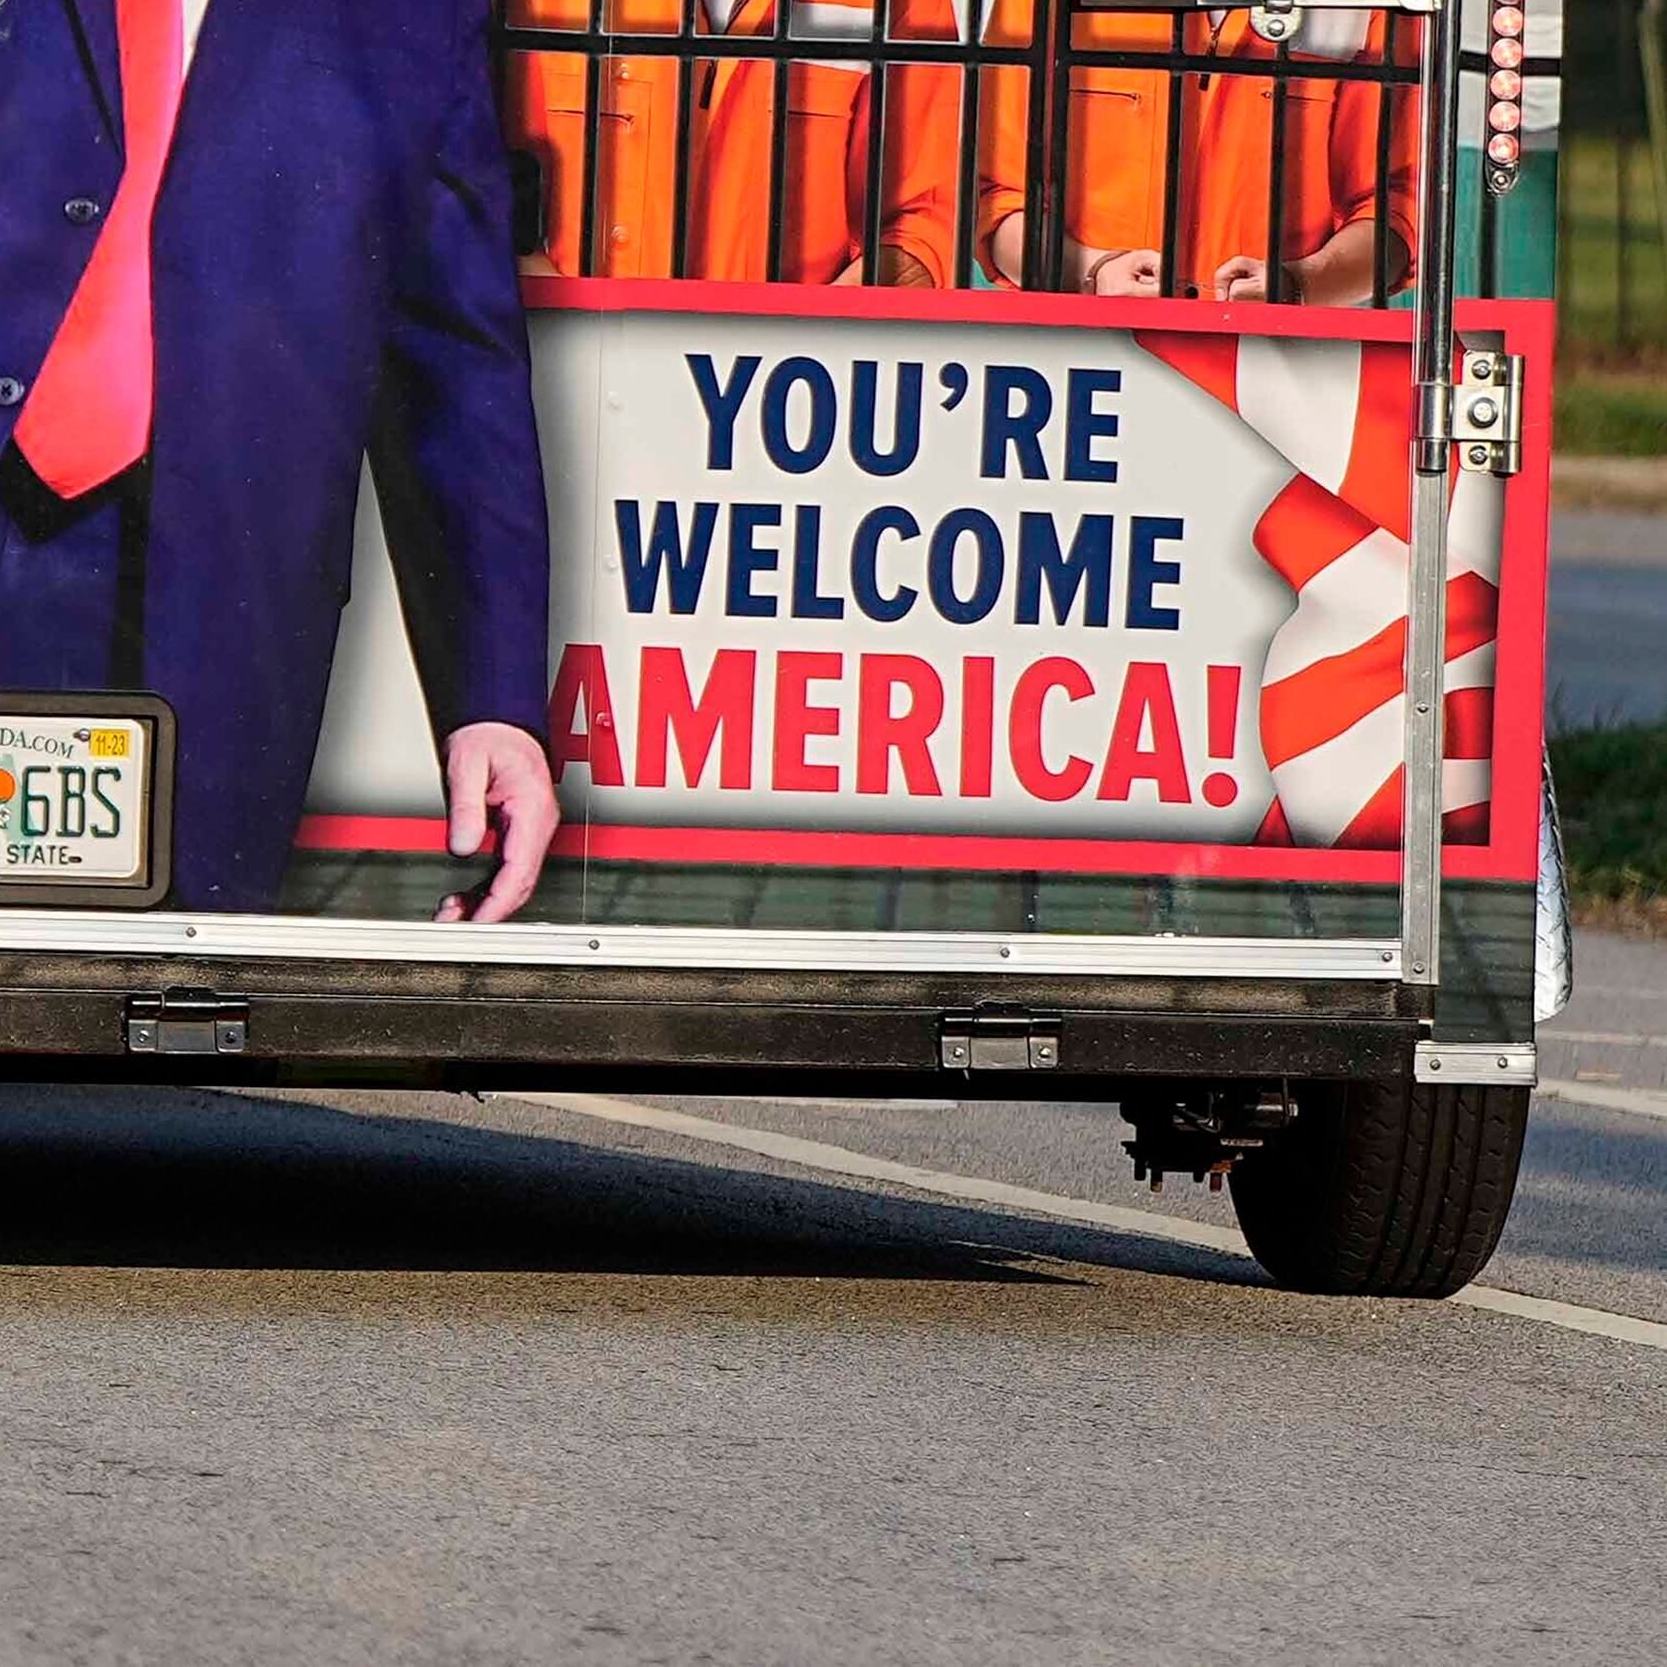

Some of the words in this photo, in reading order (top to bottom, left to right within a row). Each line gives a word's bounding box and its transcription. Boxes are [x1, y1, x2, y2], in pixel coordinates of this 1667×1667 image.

[615, 499, 1185, 631] WELCOME
[548, 643, 1242, 808] AMERICA!
[20, 766, 121, 838] 6BS
[7, 845, 68, 866] STATE
